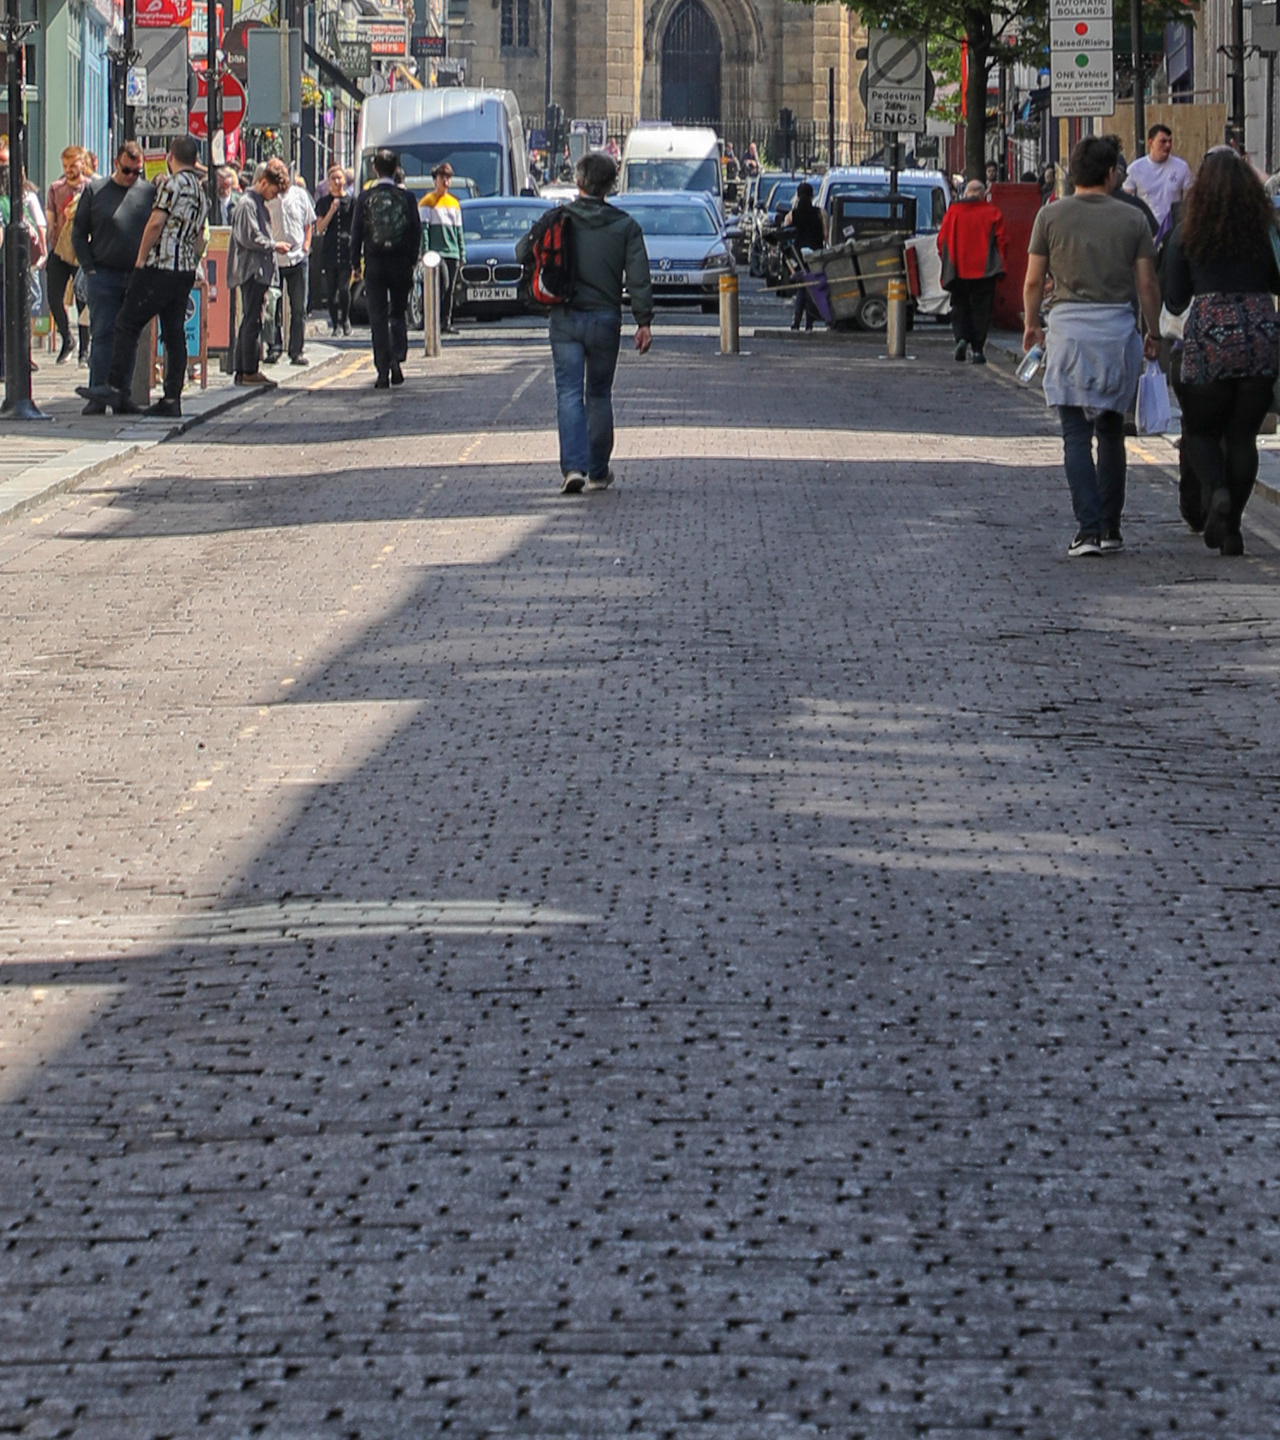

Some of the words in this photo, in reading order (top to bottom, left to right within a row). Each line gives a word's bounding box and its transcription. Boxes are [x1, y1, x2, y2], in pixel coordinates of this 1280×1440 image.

[1058, 7, 1105, 15] BOLLARDS
[1053, 40, 1110, 48] Raised/Rising
[1056, 71, 1075, 79] ONE
[1078, 71, 1108, 79] Vehicle
[1055, 81, 1072, 89] may
[1075, 80, 1109, 89] proceed
[872, 91, 921, 100] Pedestrian
[874, 112, 917, 125] ENDS
